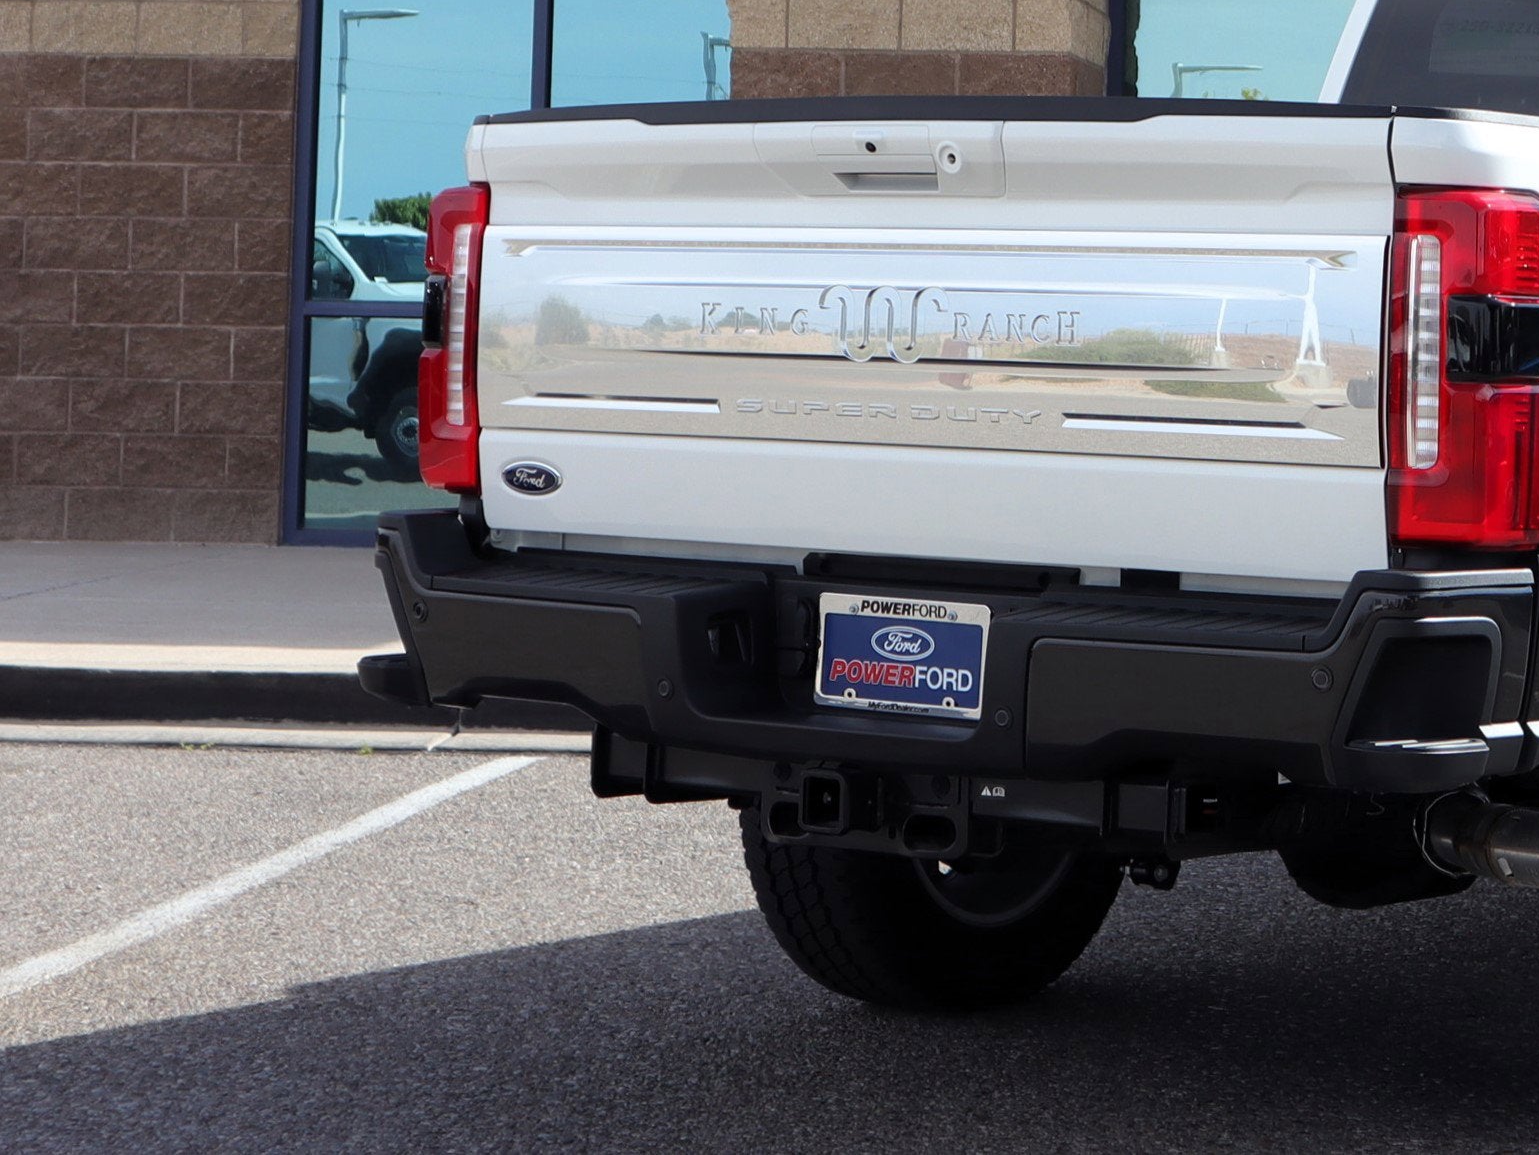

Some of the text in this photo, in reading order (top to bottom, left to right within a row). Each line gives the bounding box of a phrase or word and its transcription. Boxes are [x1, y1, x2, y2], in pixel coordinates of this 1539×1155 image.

[700, 301, 1081, 346] KING RANCH
[735, 398, 1042, 425] SUPER DUTY
[512, 467, 546, 489] Ford
[860, 599, 947, 620] POWERFORD
[883, 631, 922, 654] Ford
[829, 658, 973, 692] POWERFORD
